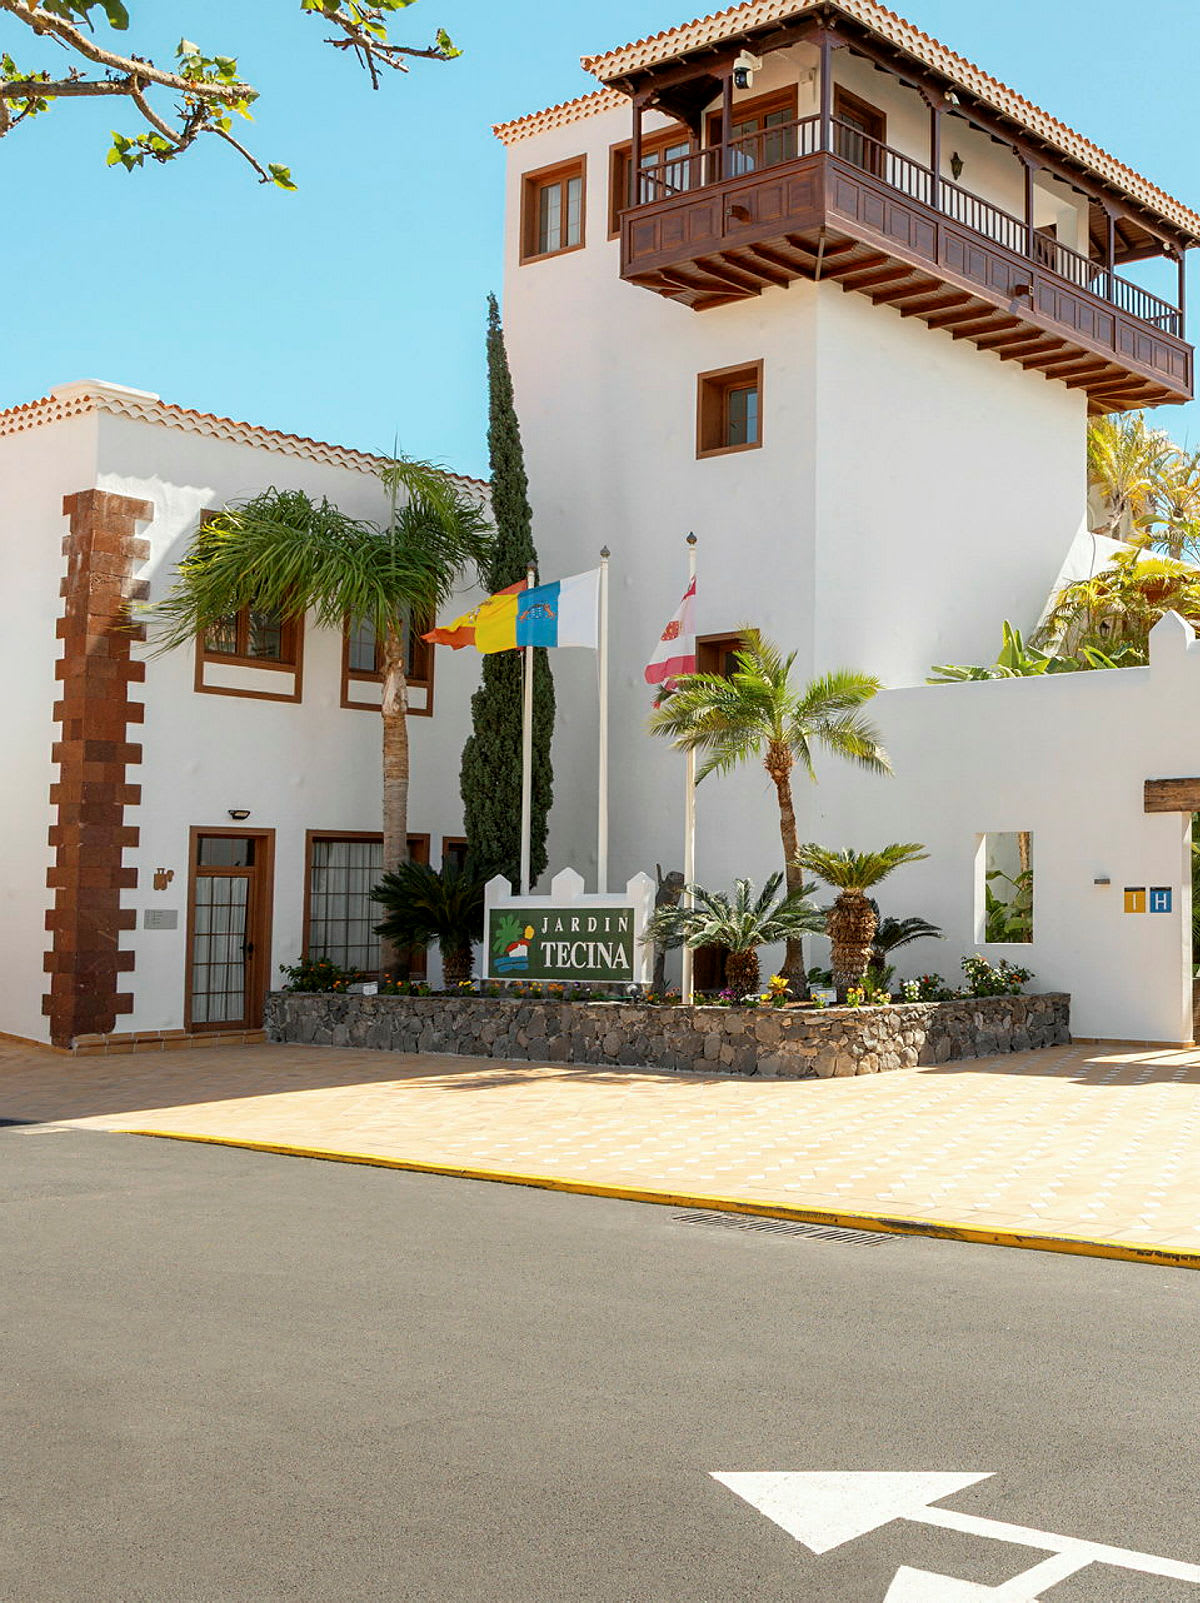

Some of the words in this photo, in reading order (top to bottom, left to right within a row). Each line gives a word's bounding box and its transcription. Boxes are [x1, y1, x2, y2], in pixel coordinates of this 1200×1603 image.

[1155, 893, 1167, 910] H
[541, 917, 629, 933] JARDIN
[541, 941, 630, 969] TECINA
